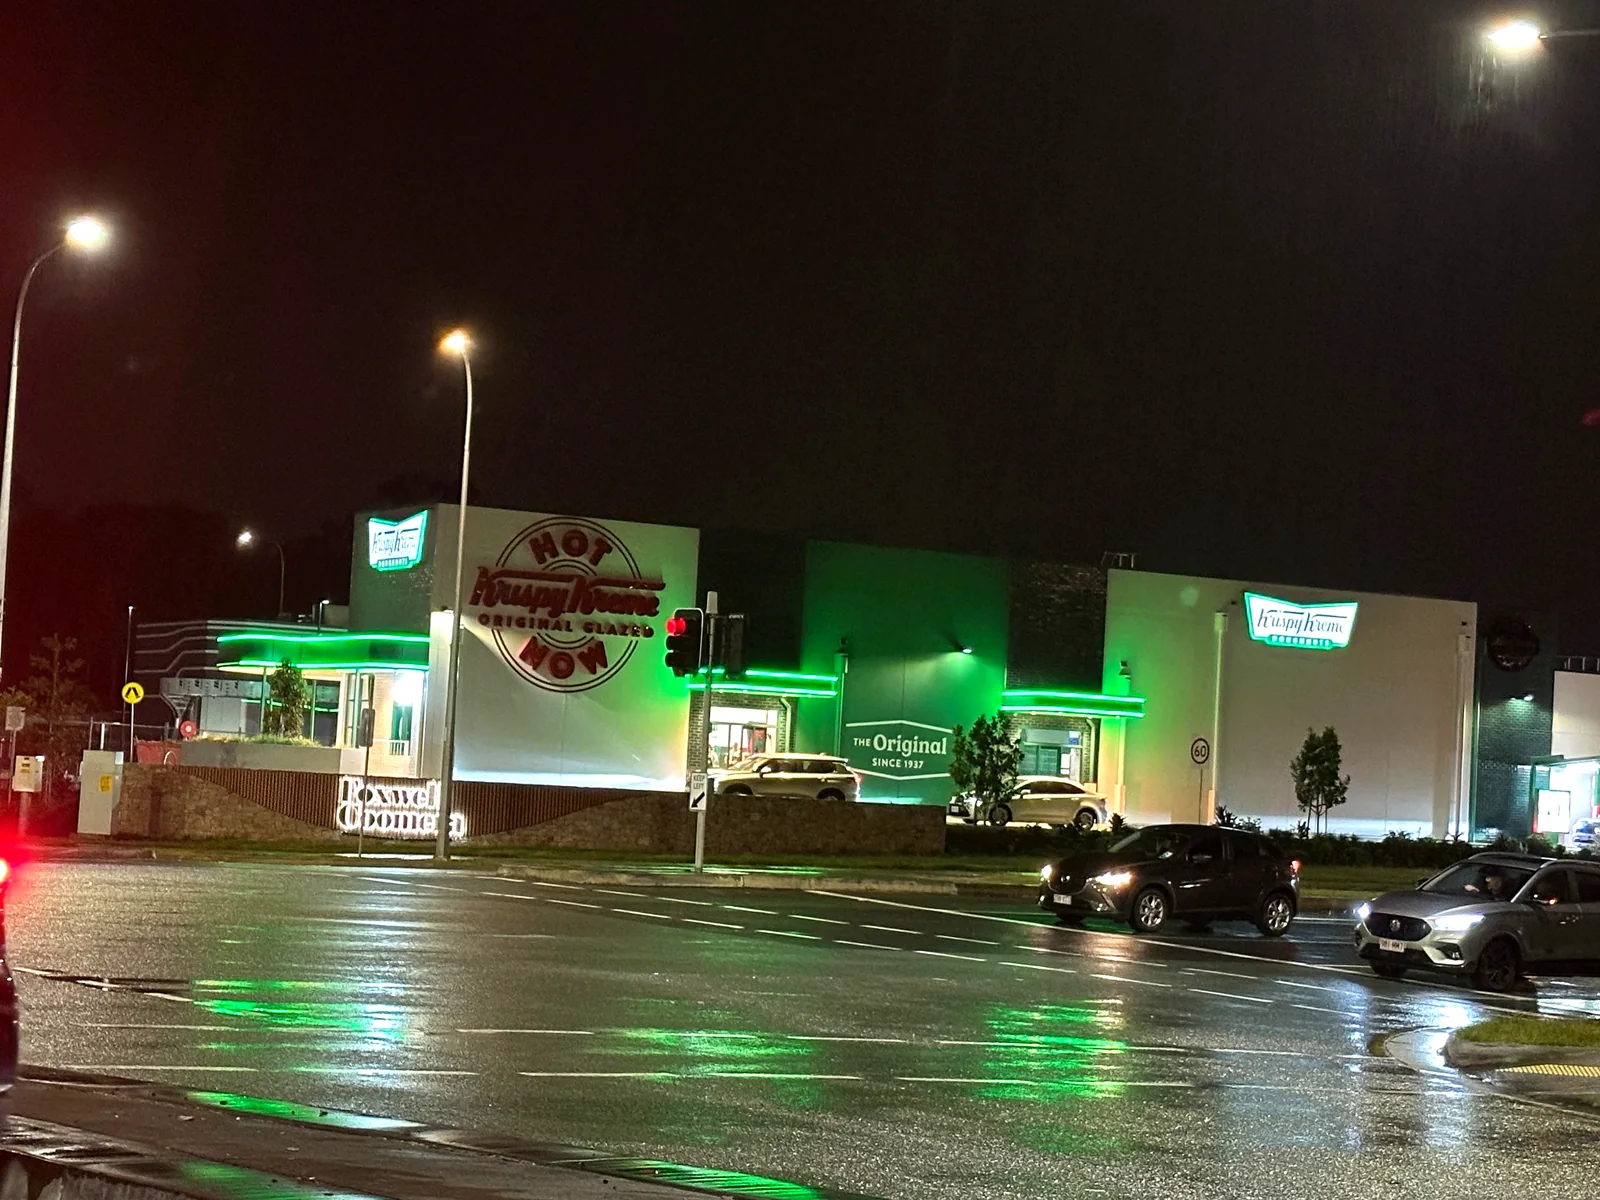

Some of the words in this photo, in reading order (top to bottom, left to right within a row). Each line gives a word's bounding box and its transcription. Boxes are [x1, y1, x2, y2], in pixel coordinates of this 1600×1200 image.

[528, 529, 613, 566] HOT
[469, 566, 581, 618] Krispy
[478, 613, 574, 633] ORIGINAL
[581, 620, 655, 639] GLAZED
[1257, 608, 1305, 634] Krispy
[1303, 612, 1348, 634] Kreme
[518, 636, 609, 680] NOW
[853, 737, 871, 747] THE
[873, 733, 947, 757] Original
[1194, 745, 1207, 757] 60
[872, 757, 902, 768] SINCE
[904, 760, 924, 769] 1937
